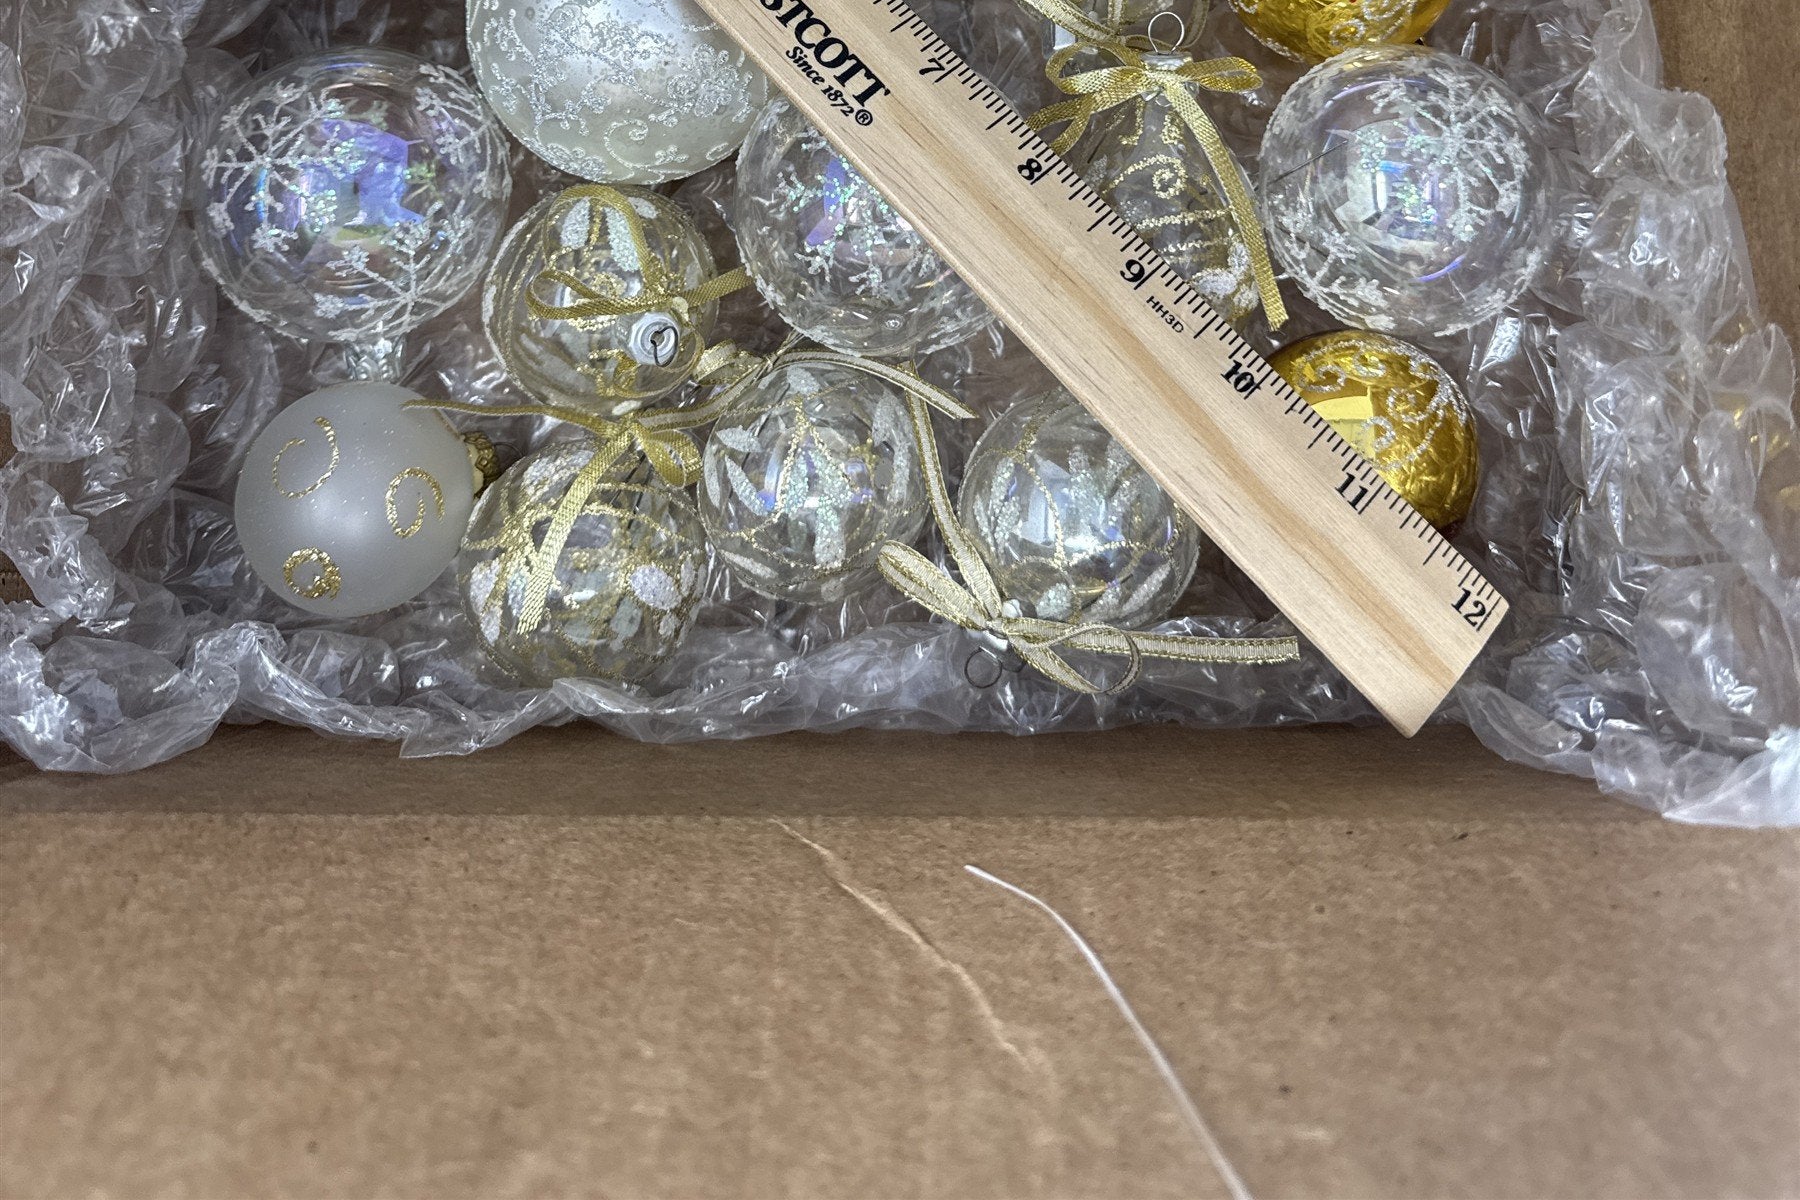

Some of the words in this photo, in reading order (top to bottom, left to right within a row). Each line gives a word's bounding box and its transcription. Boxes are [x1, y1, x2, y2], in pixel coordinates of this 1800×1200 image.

[786, 46, 825, 85] Since
[919, 58, 945, 77] 7
[1017, 158, 1043, 182] 8
[1119, 258, 1146, 284] 9
[1146, 296, 1184, 333] HH3D
[1220, 360, 1255, 393] 10
[1334, 472, 1366, 510] 11
[1451, 588, 1487, 626] 12
